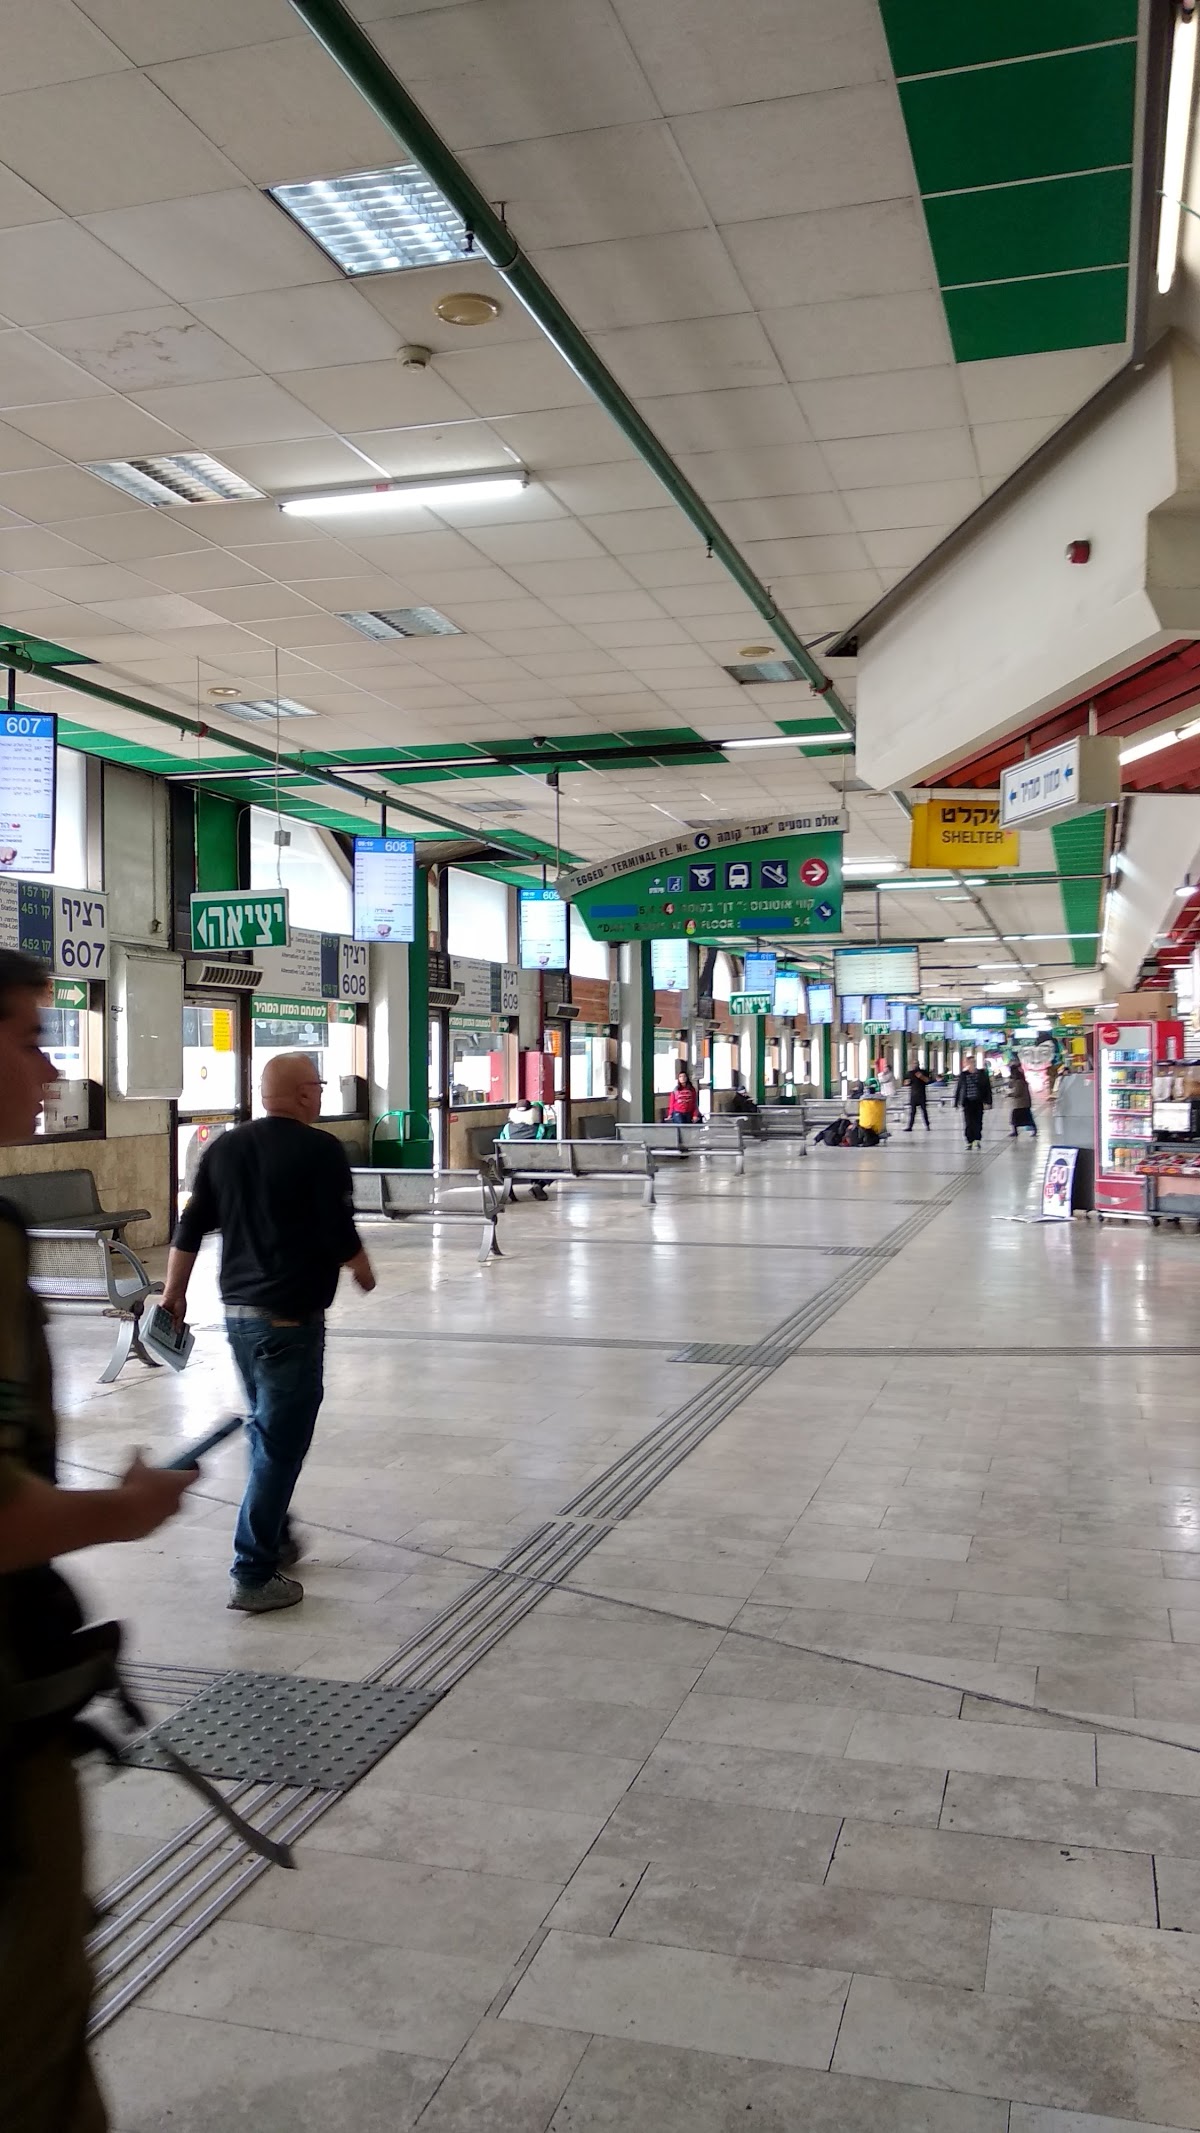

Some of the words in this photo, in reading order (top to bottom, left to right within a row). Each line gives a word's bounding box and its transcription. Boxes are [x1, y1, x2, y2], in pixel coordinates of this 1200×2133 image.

[6, 716, 41, 734] 607
[815, 814, 839, 827] אולם
[717, 828, 742, 843] קומה
[942, 831, 1003, 844] SHELTER
[385, 841, 407, 852] 608
[570, 866, 608, 886] "EGGED"
[611, 852, 657, 873] TERMINAL
[659, 847, 673, 857] FL.
[698, 836, 707, 848] 6
[22, 886, 39, 898] 157
[41, 889, 50, 902] קו
[21, 903, 38, 915] 451
[41, 905, 50, 919] קו
[61, 897, 105, 932] רציף
[208, 903, 283, 947] יציאה
[21, 938, 39, 950] 452
[41, 940, 51, 954] קו
[61, 939, 105, 968] 607
[343, 944, 366, 969] רציף
[342, 974, 366, 995] 608
[503, 970, 518, 989] רציף
[254, 1002, 278, 1014] המהיר
[503, 993, 518, 1009] 609
[736, 997, 770, 1013] יציאה
[280, 1004, 299, 1016] המזון
[300, 1005, 326, 1017] למתחם
[1050, 1167, 1067, 1184] 80
